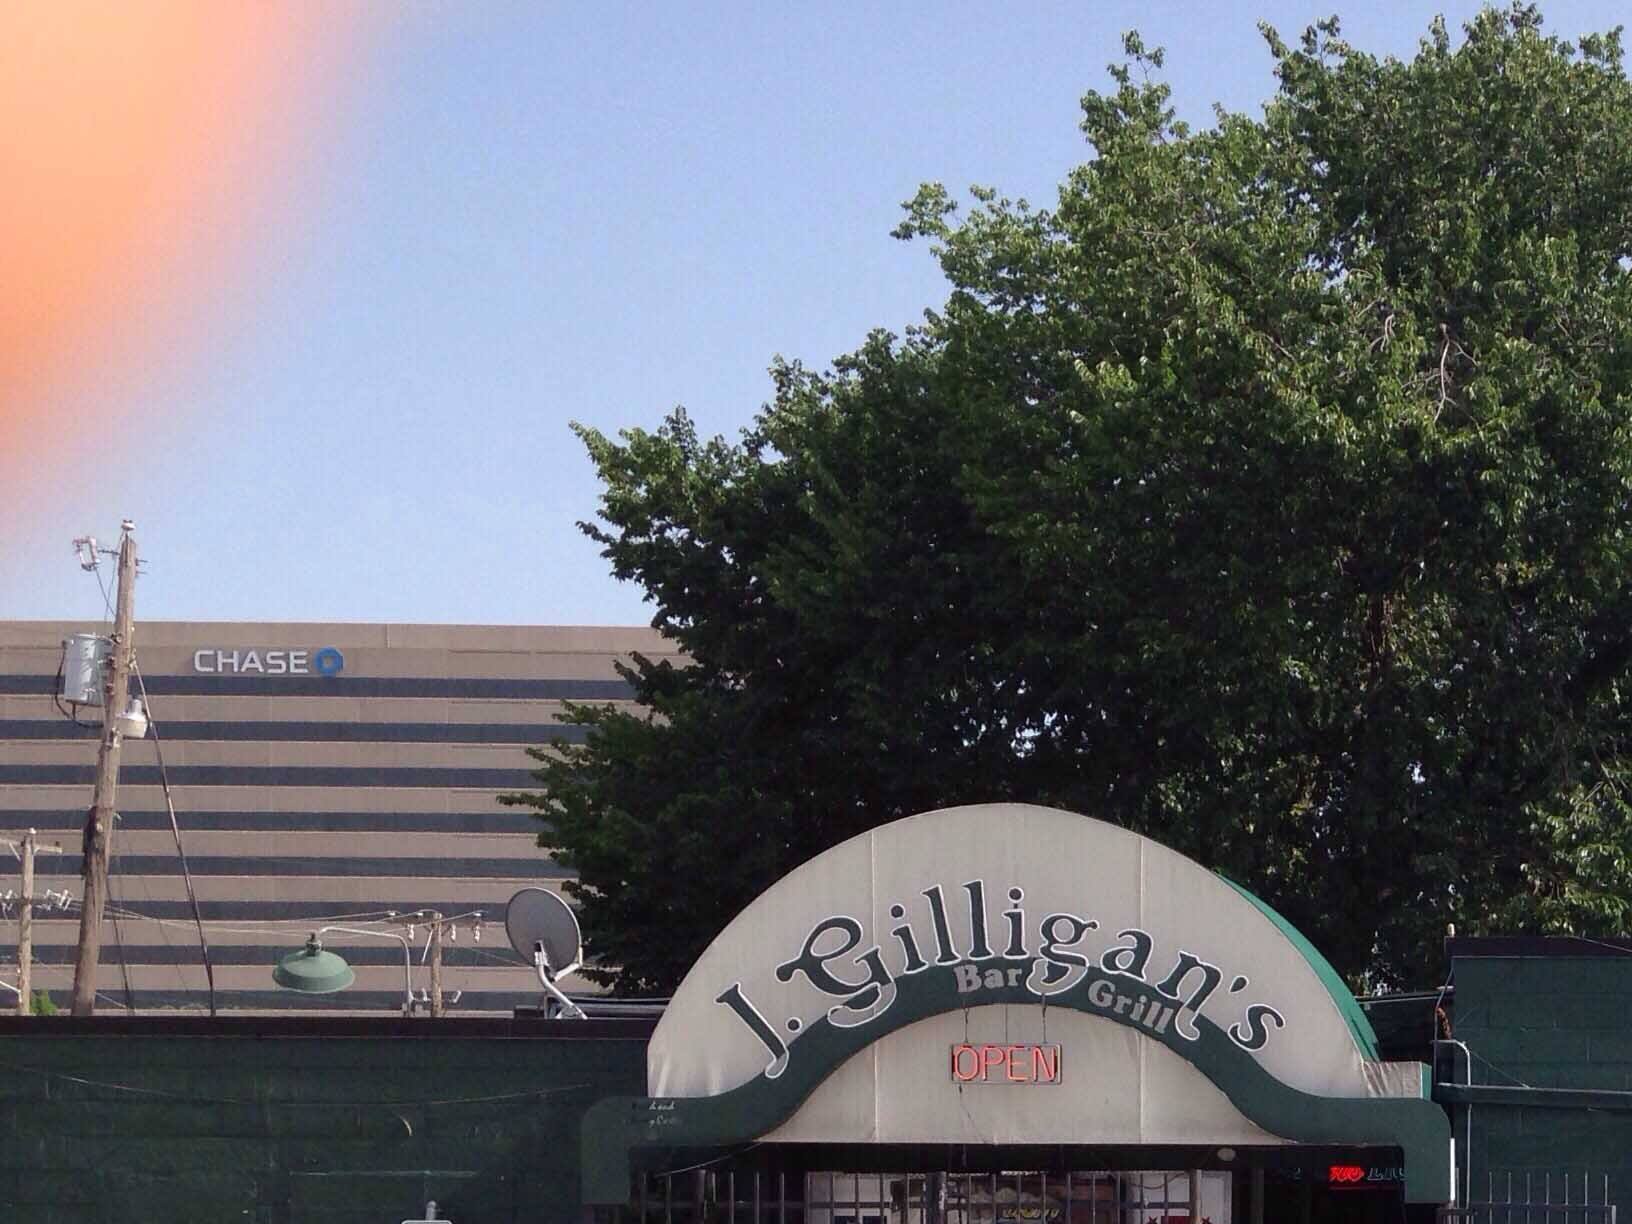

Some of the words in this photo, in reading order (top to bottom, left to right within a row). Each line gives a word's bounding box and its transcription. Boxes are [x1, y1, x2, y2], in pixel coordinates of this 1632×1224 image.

[194, 650, 309, 674] CHASE
[953, 964, 1022, 993] Bar
[1088, 979, 1174, 1034] Grill
[953, 1045, 1058, 1082] OPEN
